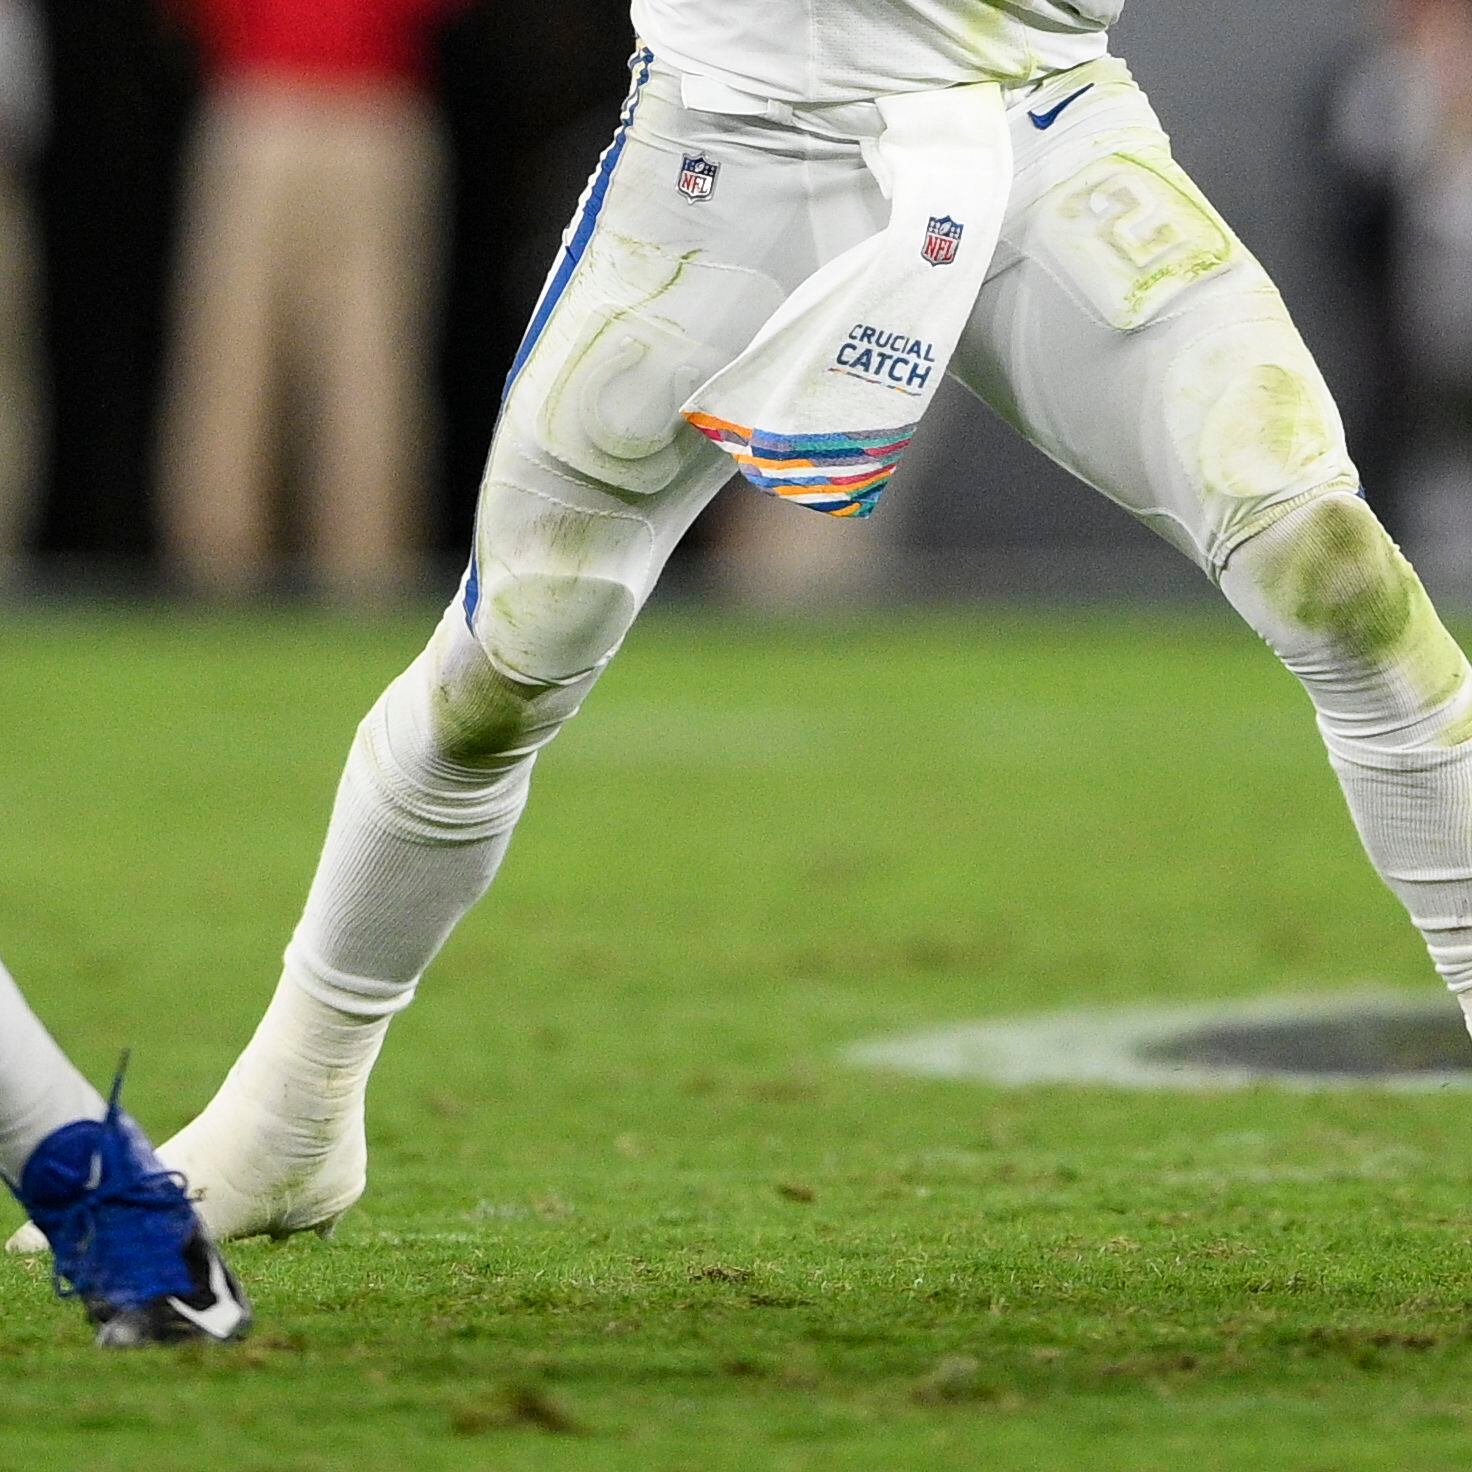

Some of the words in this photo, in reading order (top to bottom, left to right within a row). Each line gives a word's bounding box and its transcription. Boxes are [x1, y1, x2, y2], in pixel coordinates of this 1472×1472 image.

[681, 172, 709, 194] NFL
[924, 234, 954, 262] NFL
[848, 324, 935, 362] CRUCIAL
[836, 343, 932, 389] CATCH
